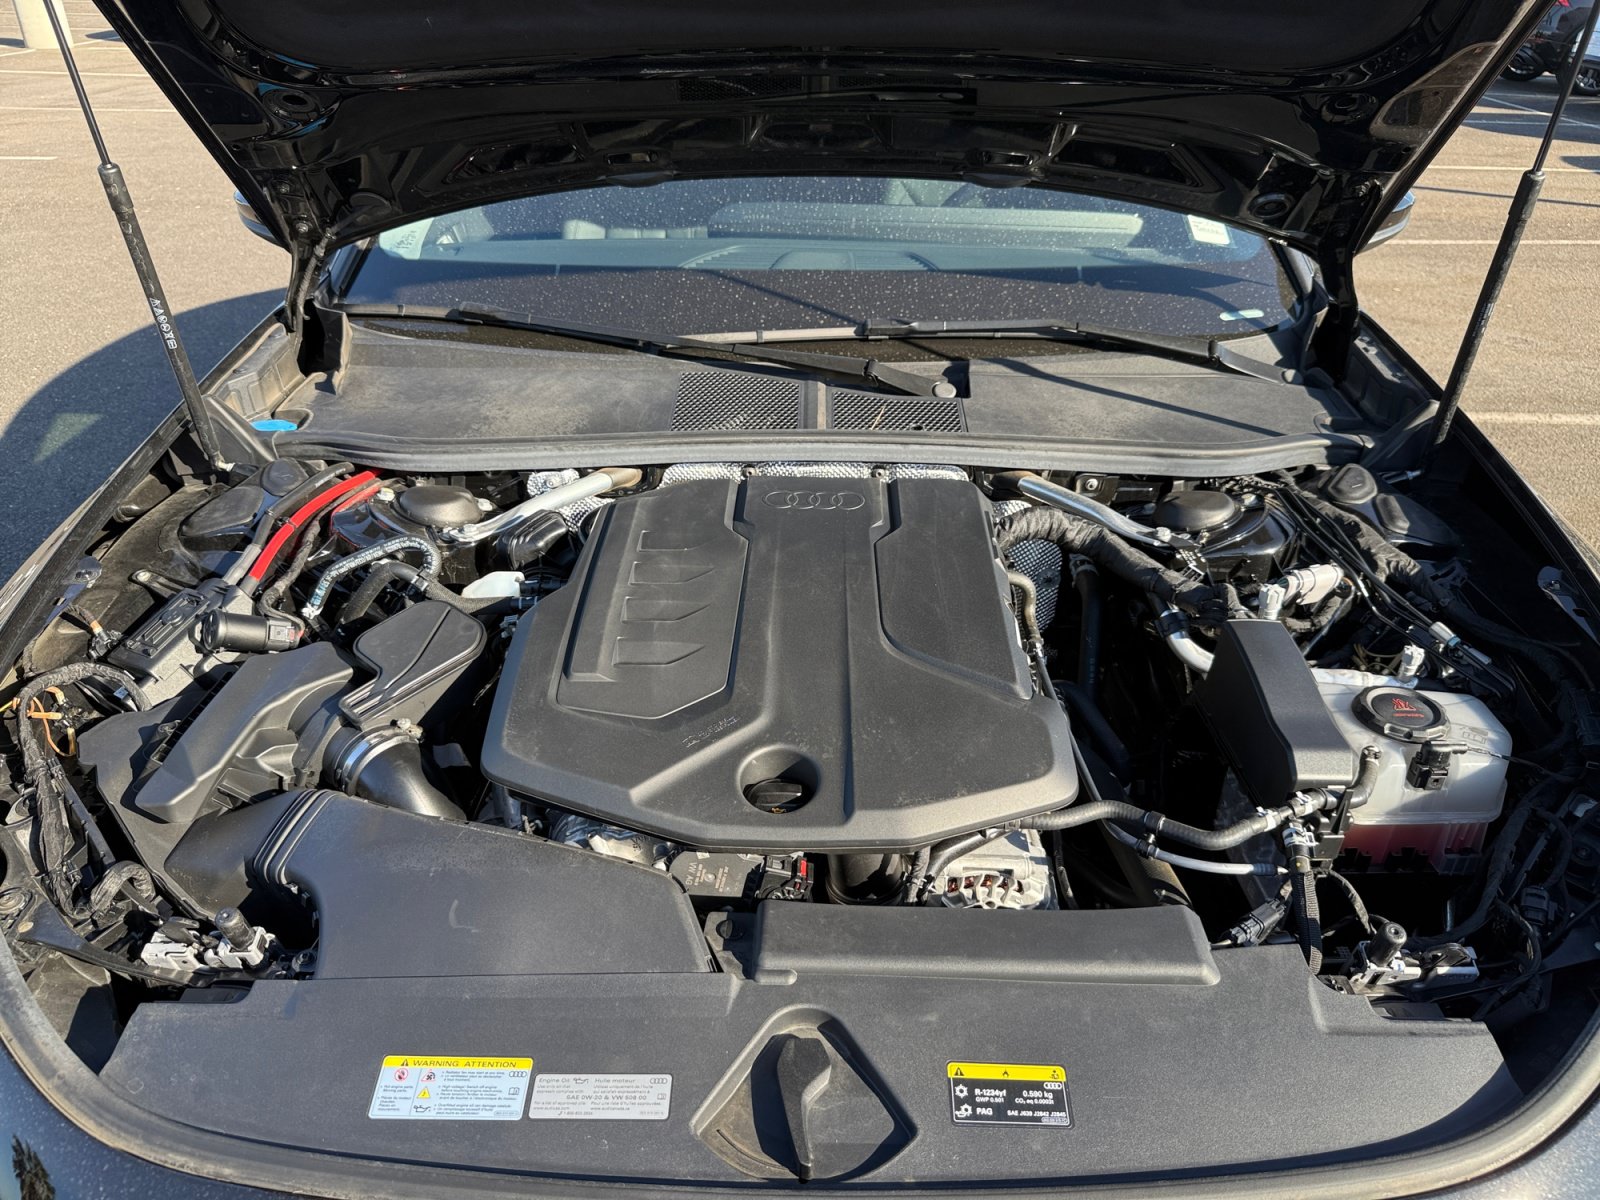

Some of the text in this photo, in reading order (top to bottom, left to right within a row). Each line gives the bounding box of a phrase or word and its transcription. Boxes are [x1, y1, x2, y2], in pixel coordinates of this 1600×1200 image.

[685, 862, 697, 886] VW AG
[413, 1059, 460, 1067] WARNING
[974, 1088, 1006, 1097] R-1234yf
[1044, 1090, 1053, 1099] kg
[976, 1107, 993, 1115] PAG
